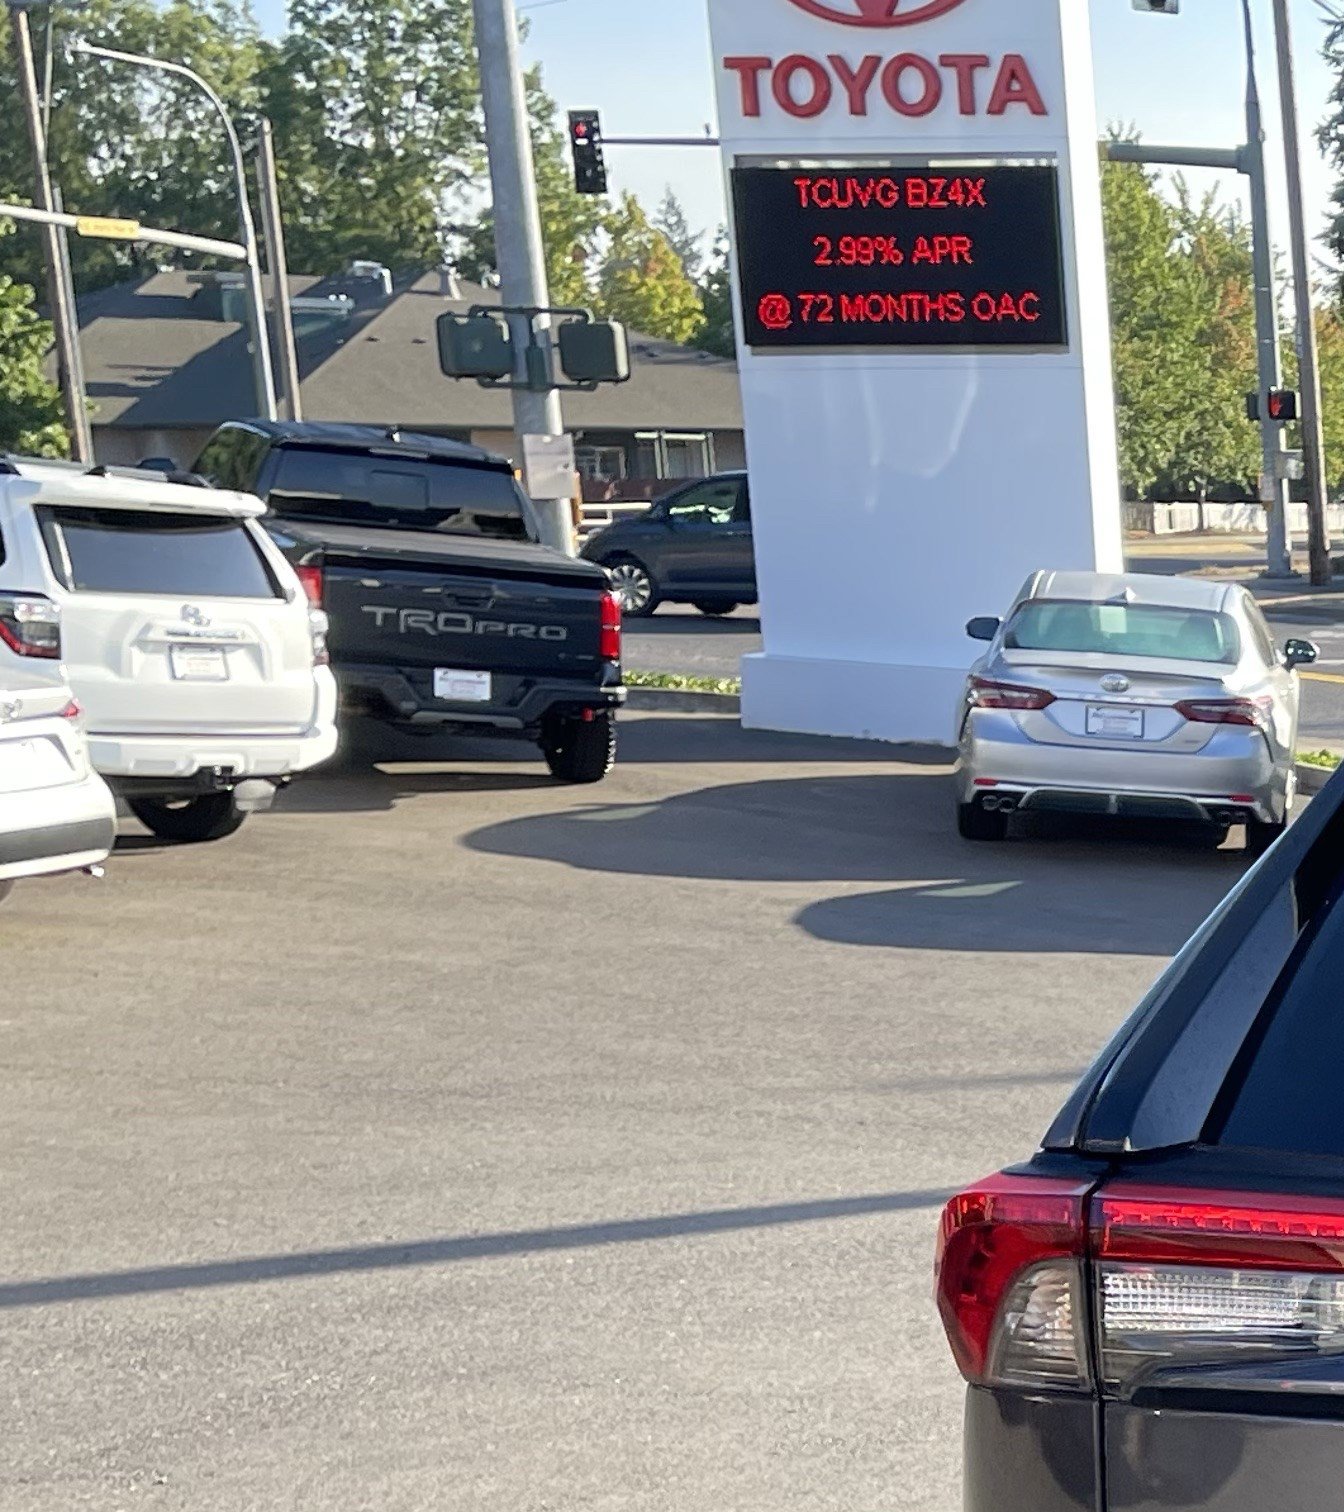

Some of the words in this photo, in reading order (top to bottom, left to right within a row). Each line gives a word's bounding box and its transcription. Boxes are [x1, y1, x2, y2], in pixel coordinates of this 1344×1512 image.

[723, 53, 1048, 118] TOYOTA
[794, 177, 899, 209] TCUVG
[905, 177, 988, 209] BZ4X
[812, 235, 902, 266] 2.99%
[912, 235, 975, 265] APR
[758, 293, 793, 329] @
[798, 293, 834, 322] 72
[840, 291, 966, 323] MONTHS
[972, 292, 1042, 322] OAC
